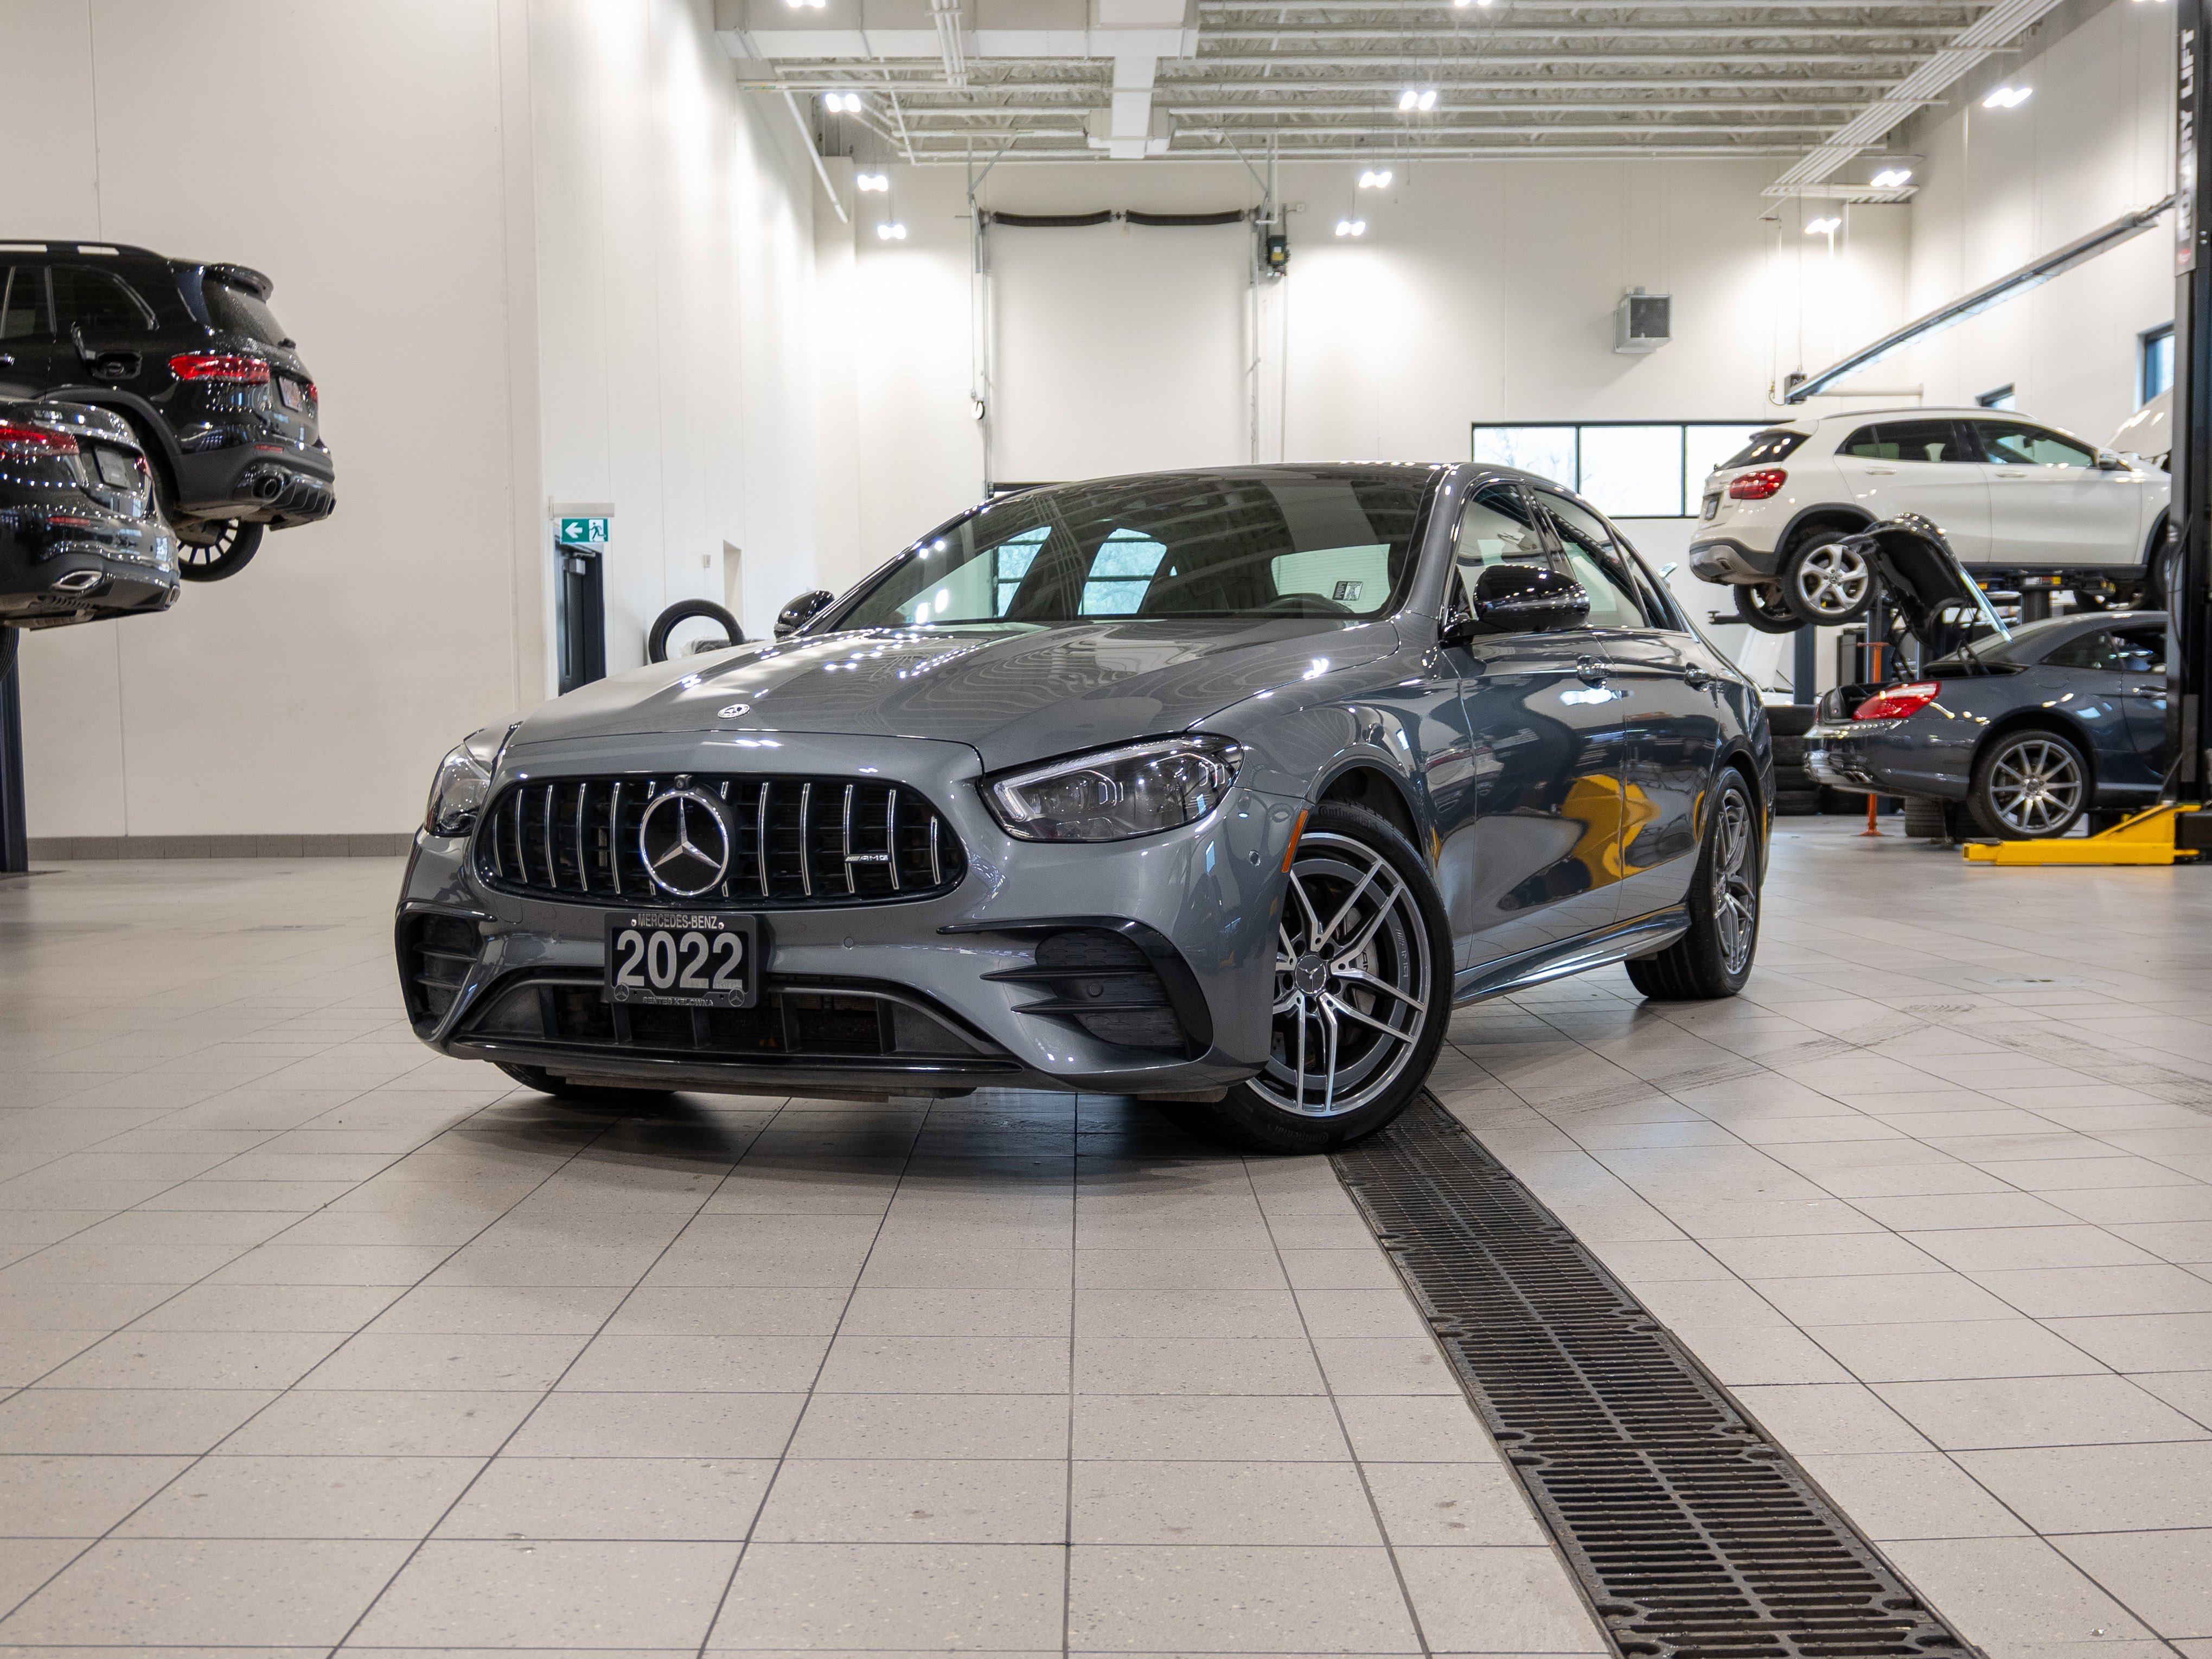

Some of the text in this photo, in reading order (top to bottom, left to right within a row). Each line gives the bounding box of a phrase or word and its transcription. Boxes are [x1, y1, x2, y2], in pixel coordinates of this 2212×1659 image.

[2180, 29, 2195, 100] LIFT
[638, 914, 717, 929] MERCEDES-BENZ
[617, 929, 743, 989] 2022
[674, 998, 714, 1007] KELOWNA
